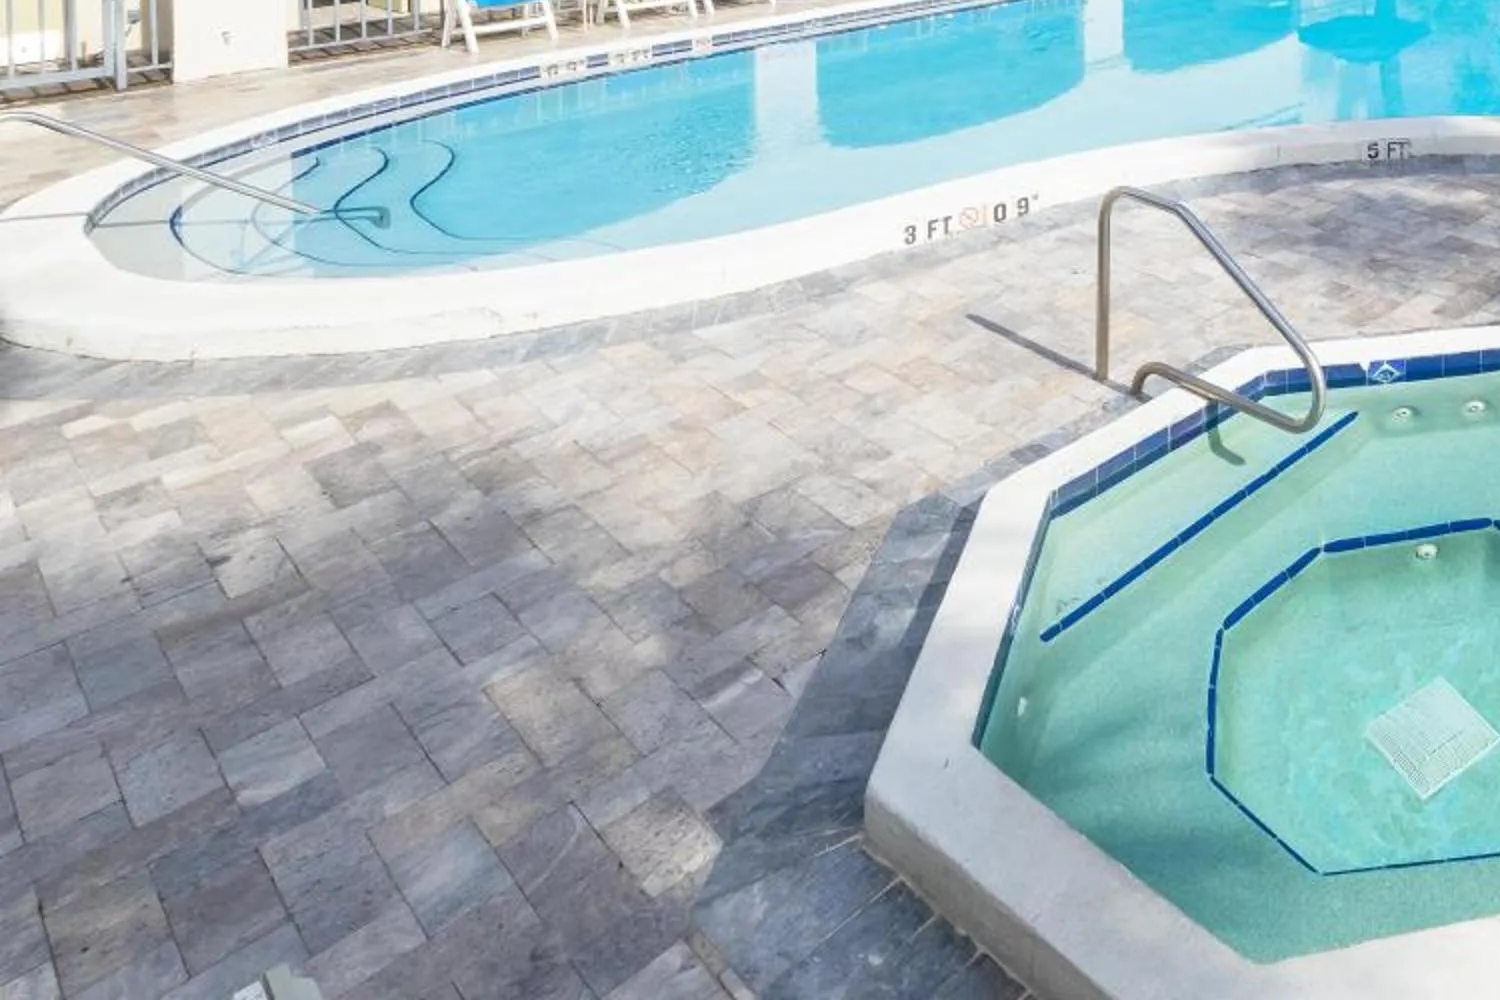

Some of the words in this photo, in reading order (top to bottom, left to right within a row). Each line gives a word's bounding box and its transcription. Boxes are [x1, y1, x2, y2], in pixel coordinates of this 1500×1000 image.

[1367, 142, 1379, 159] 5
[1387, 141, 1409, 161] FT
[904, 225, 917, 245] 3
[927, 215, 953, 239] FT
